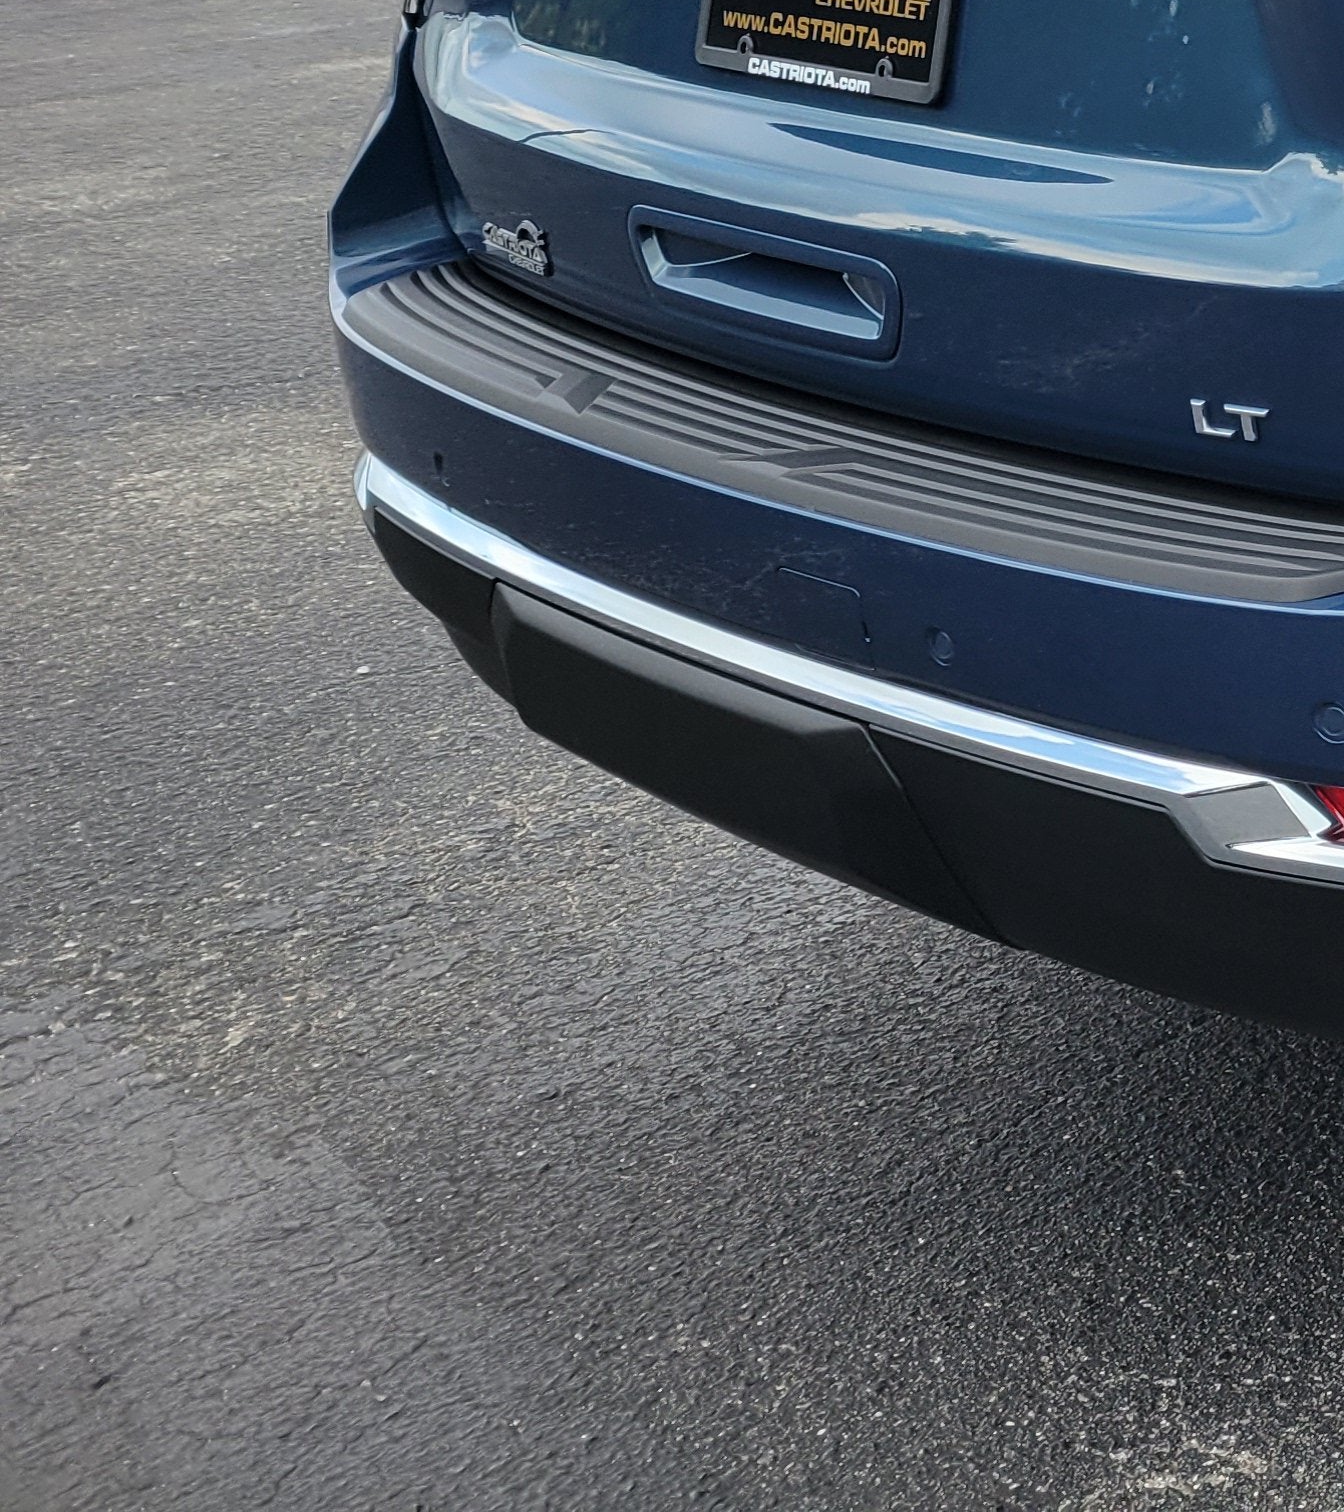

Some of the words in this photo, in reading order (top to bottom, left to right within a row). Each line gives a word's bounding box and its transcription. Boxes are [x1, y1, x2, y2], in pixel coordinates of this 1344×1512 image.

[723, 10, 927, 58] www.CASTRIOTA.com
[747, 57, 871, 94] CASTRIOTA.com
[1190, 398, 1271, 442] LT
